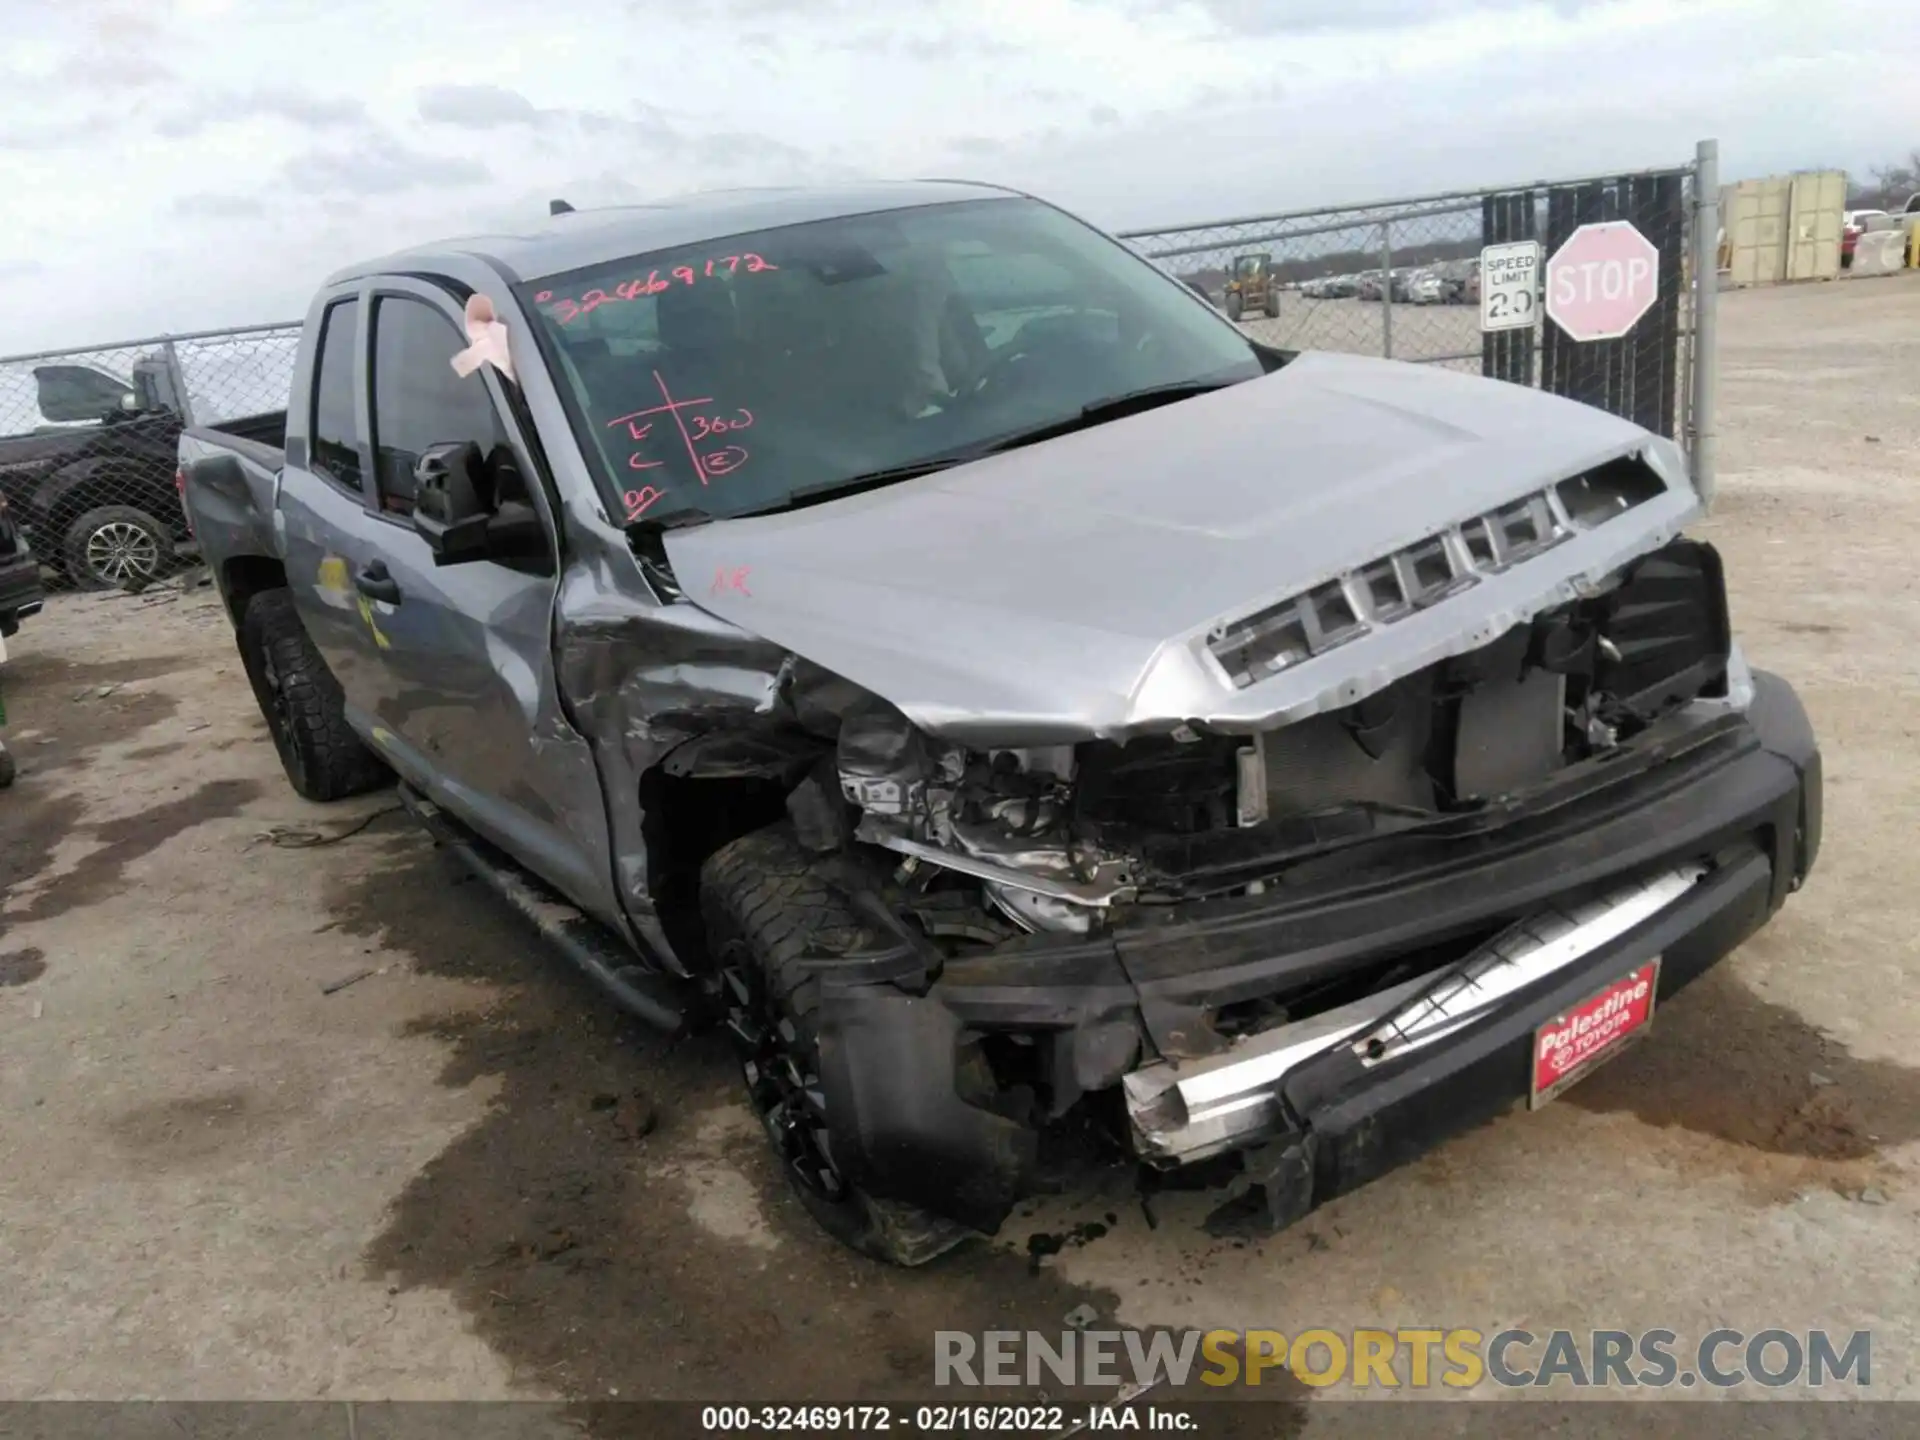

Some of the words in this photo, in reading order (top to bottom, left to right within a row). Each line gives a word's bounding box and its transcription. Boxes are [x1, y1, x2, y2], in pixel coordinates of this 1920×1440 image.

[1487, 255, 1535, 272] SPEED
[1492, 270, 1531, 286] LIMIT
[1555, 257, 1650, 306] STOP
[1489, 289, 1532, 318] 20
[1539, 980, 1649, 1061] Palestine
[1575, 1008, 1631, 1050] TOYOTA
